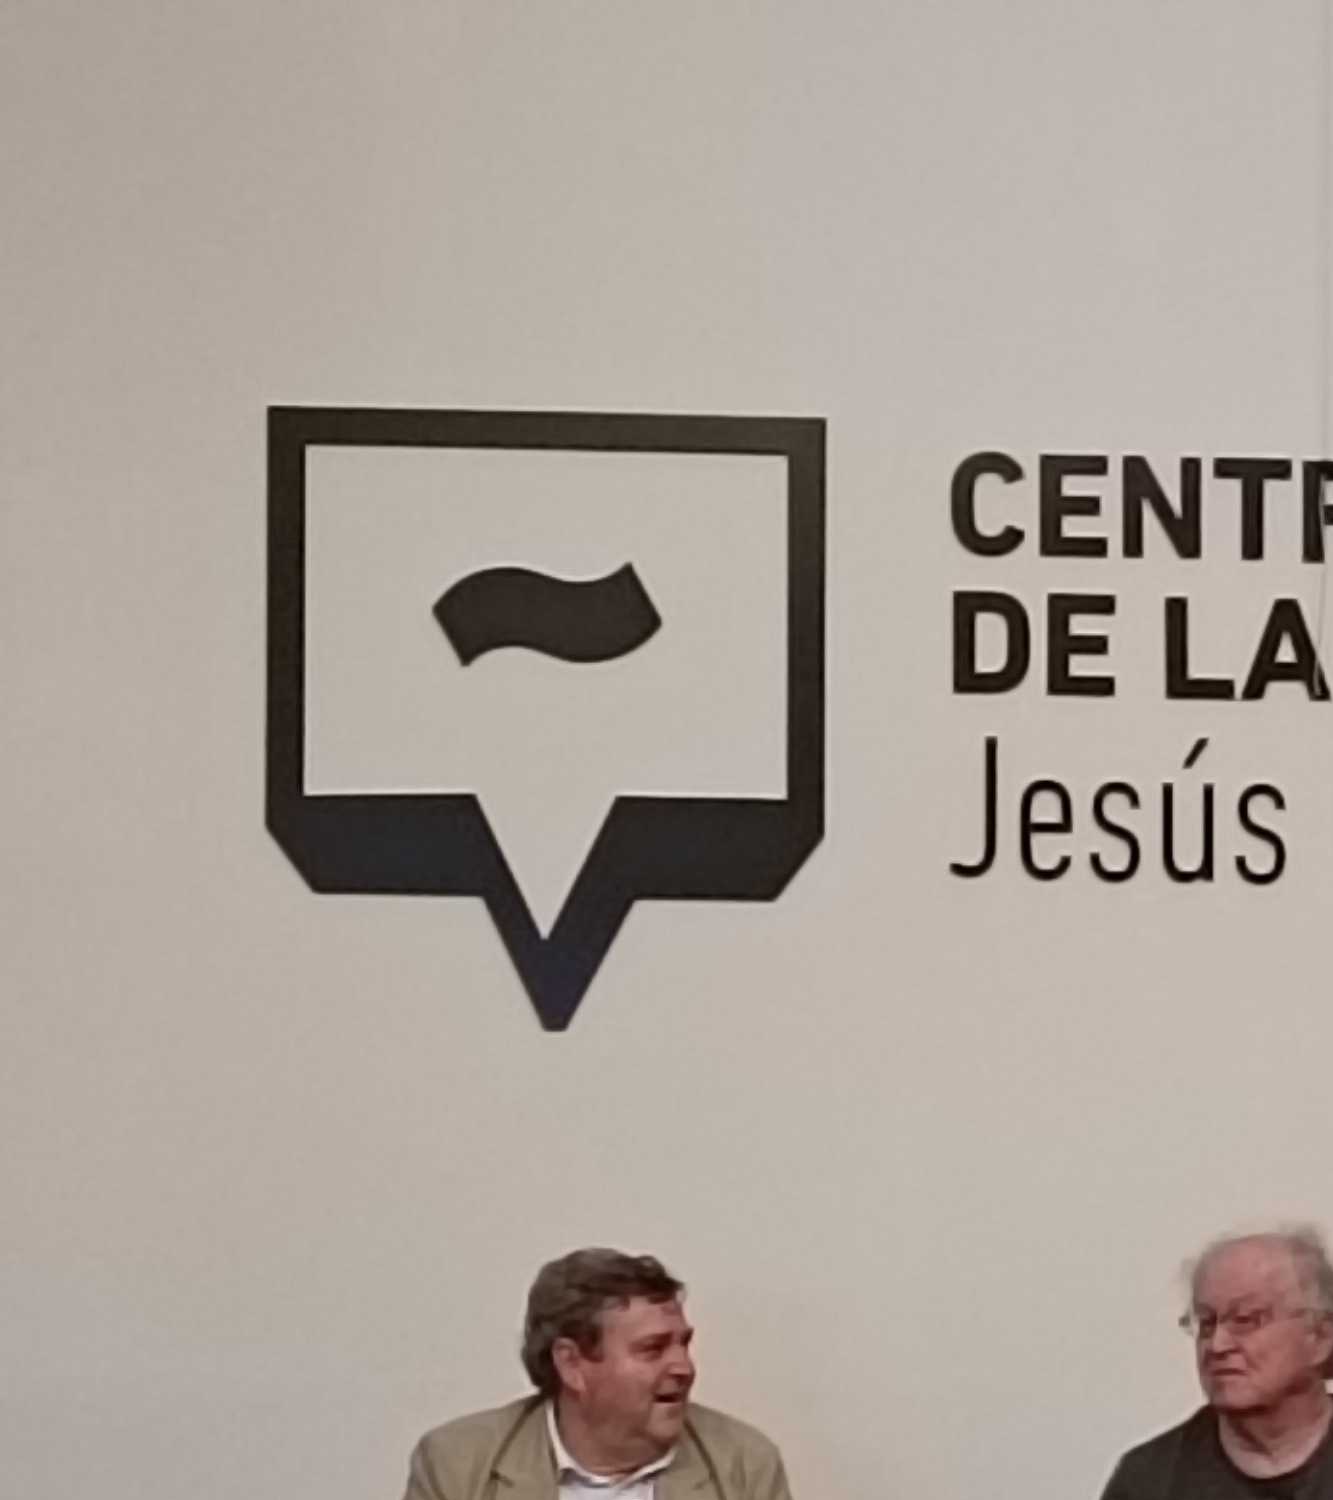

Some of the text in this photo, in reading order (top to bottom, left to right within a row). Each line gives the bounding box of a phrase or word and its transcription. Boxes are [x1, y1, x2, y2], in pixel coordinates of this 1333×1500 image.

[952, 590, 1116, 698] DE
[1164, 596, 1332, 702] LA
[949, 736, 1287, 886] Jesús
